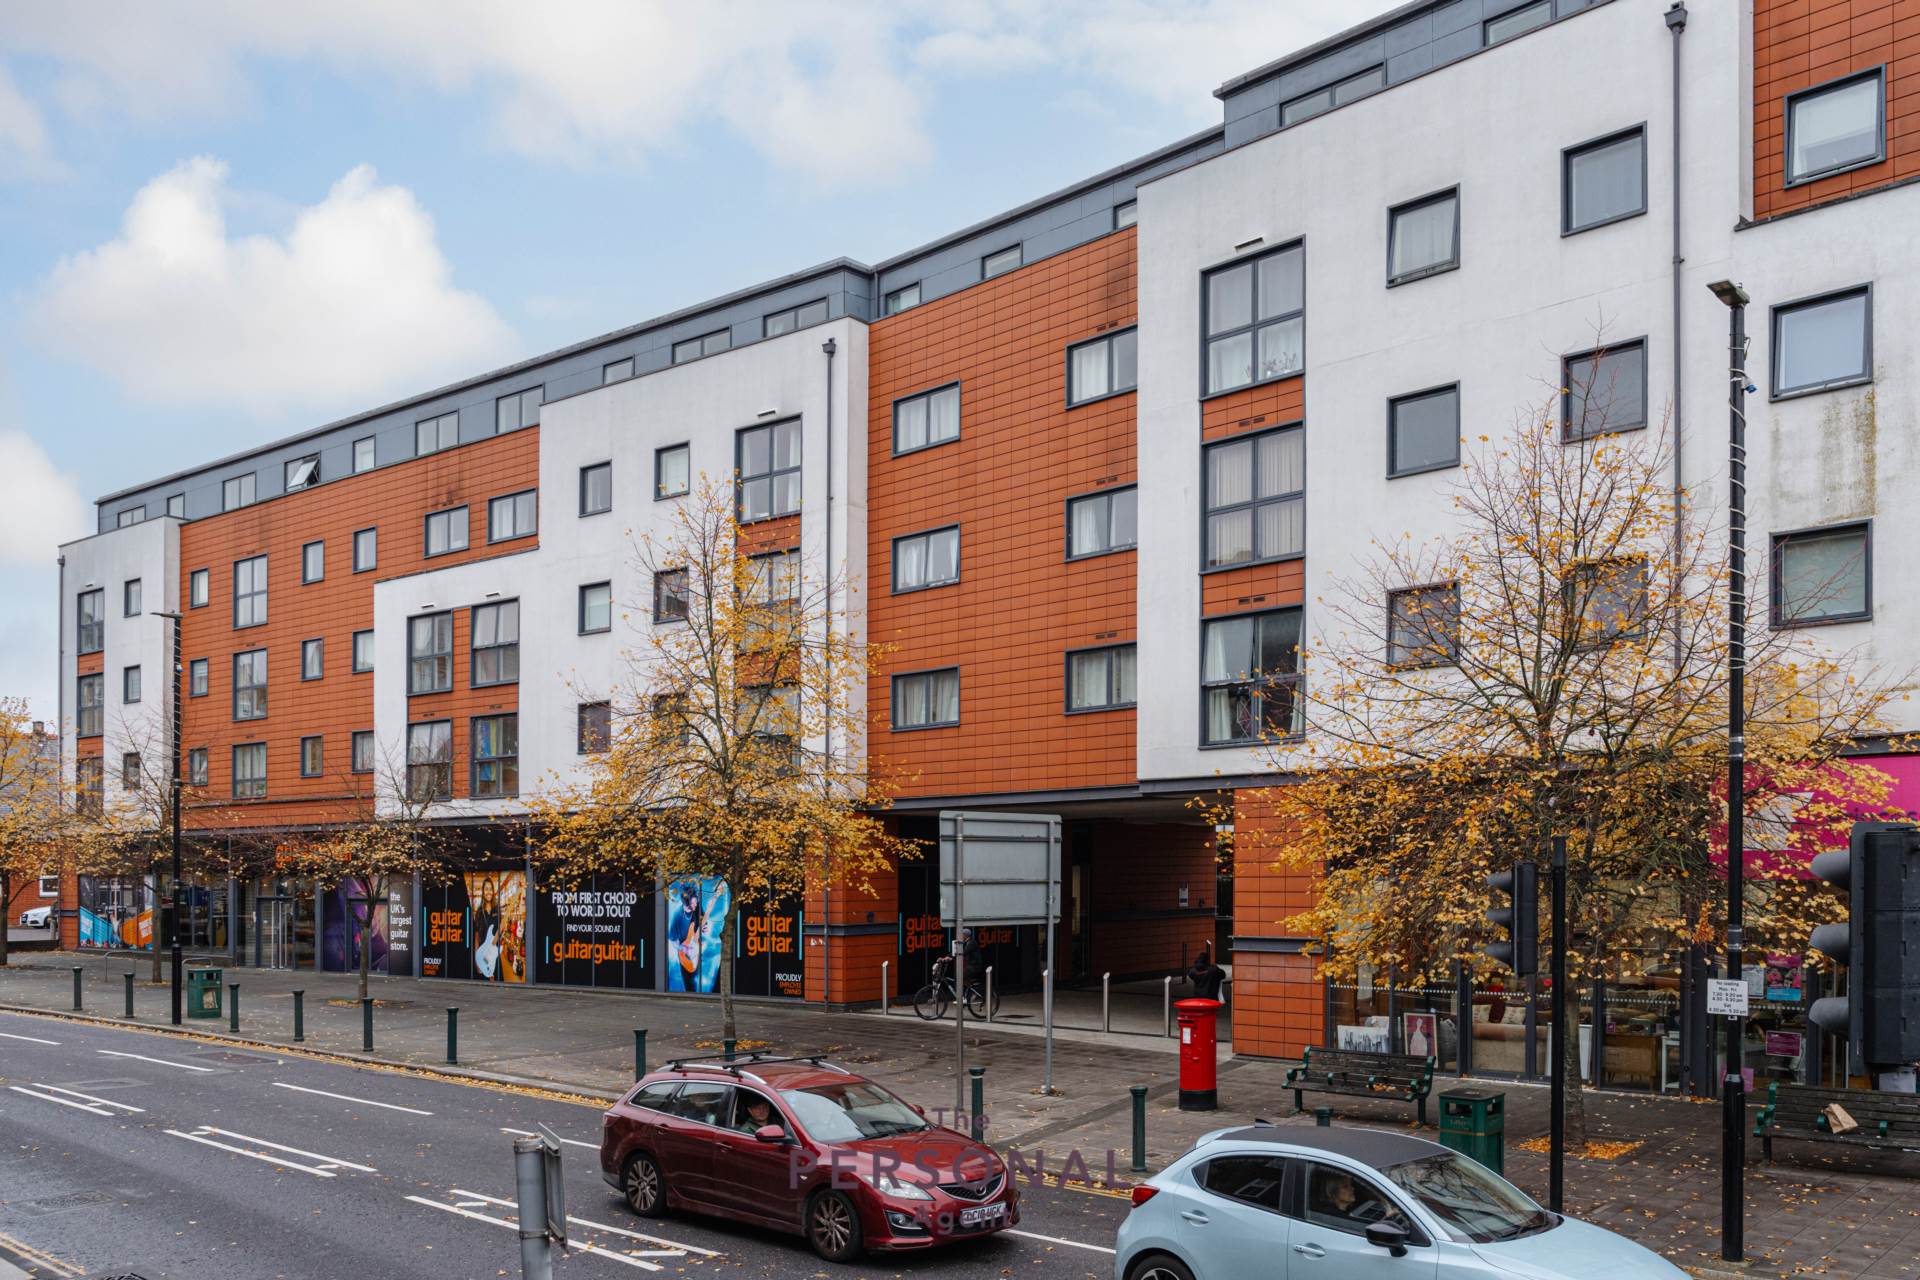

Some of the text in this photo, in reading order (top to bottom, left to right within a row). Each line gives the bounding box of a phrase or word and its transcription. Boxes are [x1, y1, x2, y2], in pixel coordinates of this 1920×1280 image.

[390, 891, 401, 902] the
[552, 892, 638, 905] FROM FIRST CHORD
[390, 904, 406, 914] UK's
[557, 905, 569, 917] TO
[606, 905, 631, 918] TOUR
[390, 916, 412, 927] largest
[905, 913, 941, 935] guita
[594, 924, 613, 933] SOUND
[390, 930, 409, 940] guitar
[775, 973, 802, 982] PROUDLY
